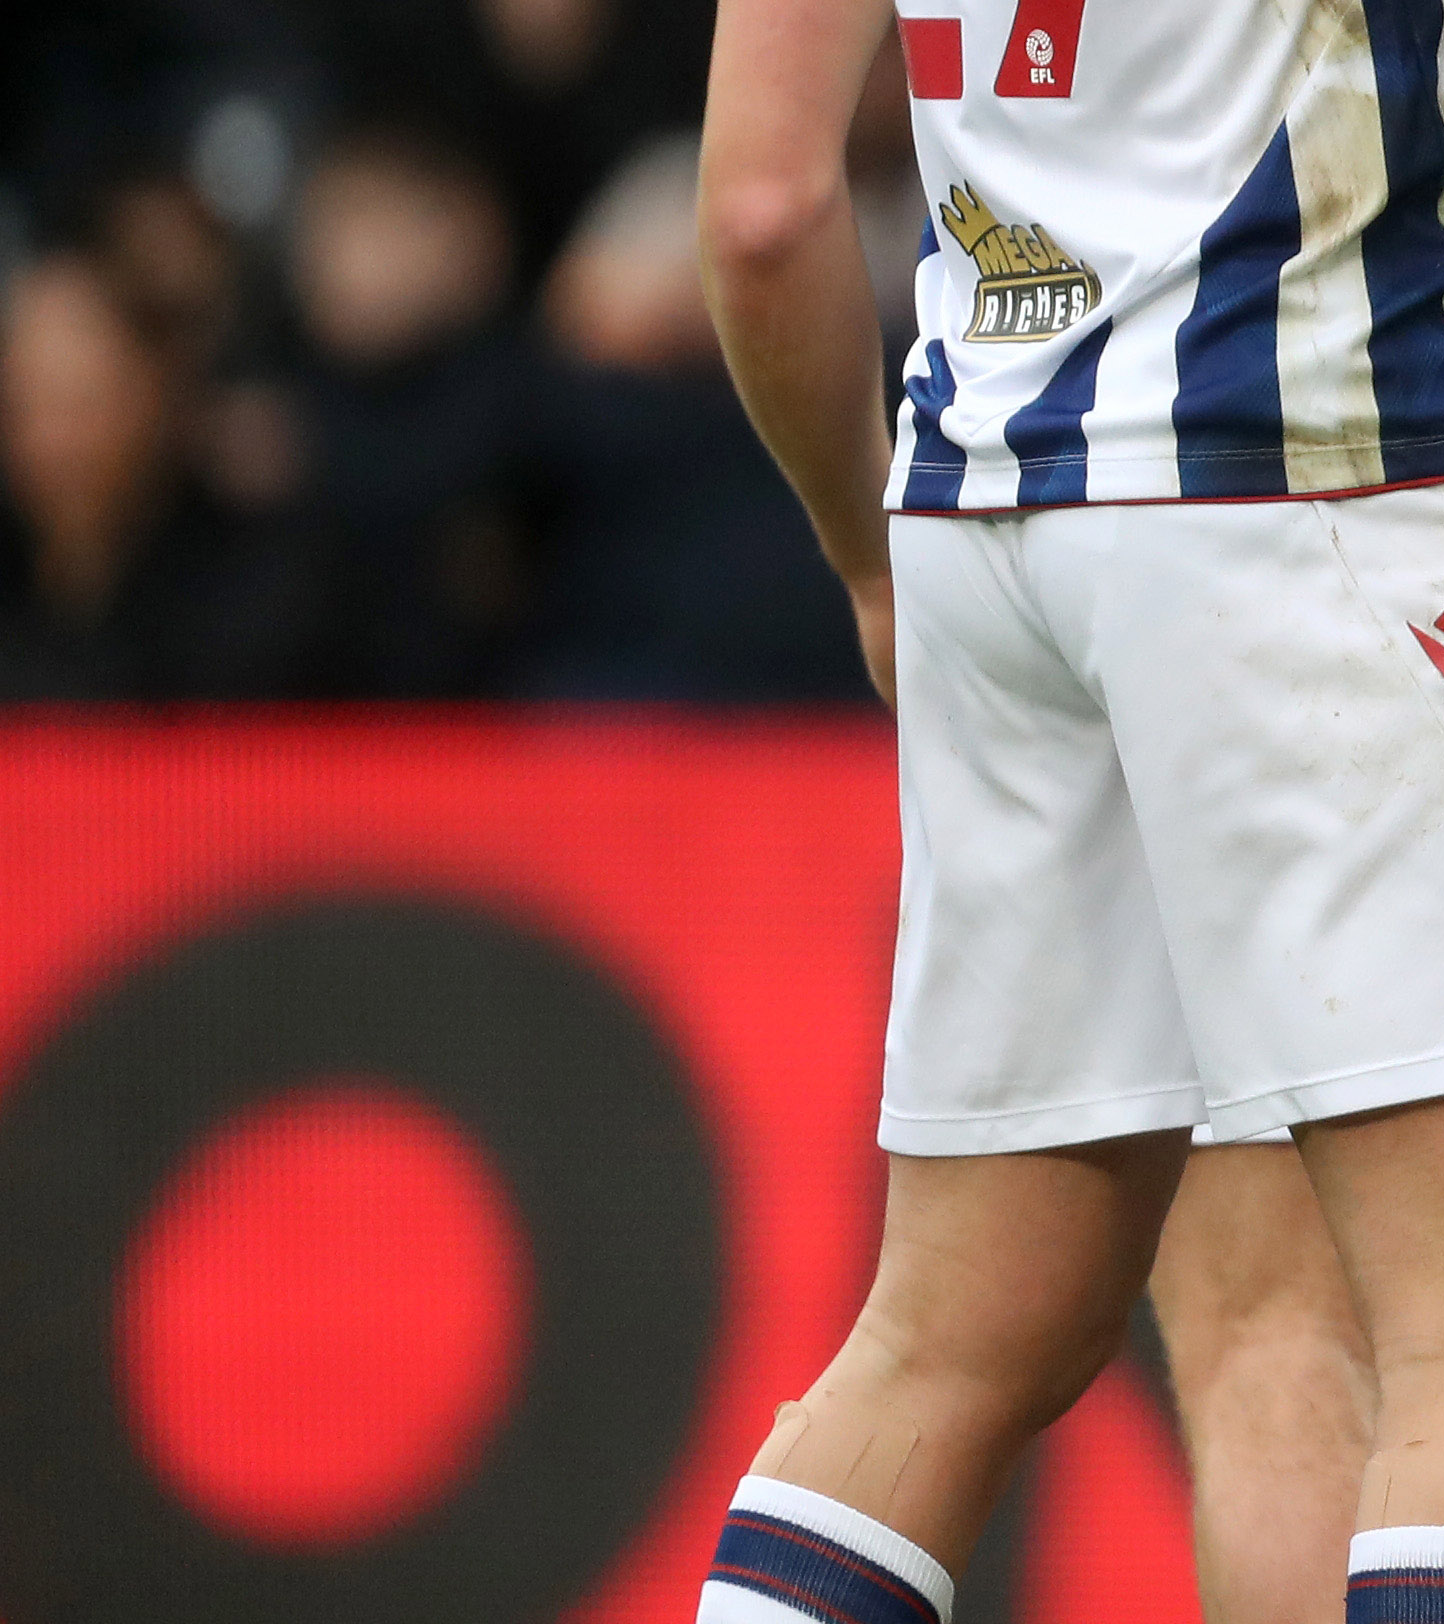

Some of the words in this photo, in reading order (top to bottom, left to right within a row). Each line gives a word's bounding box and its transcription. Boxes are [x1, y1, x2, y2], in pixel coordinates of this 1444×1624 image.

[1030, 67, 1056, 84] EFL
[971, 222, 1078, 279] MEGA
[978, 284, 1086, 334] RICHES
